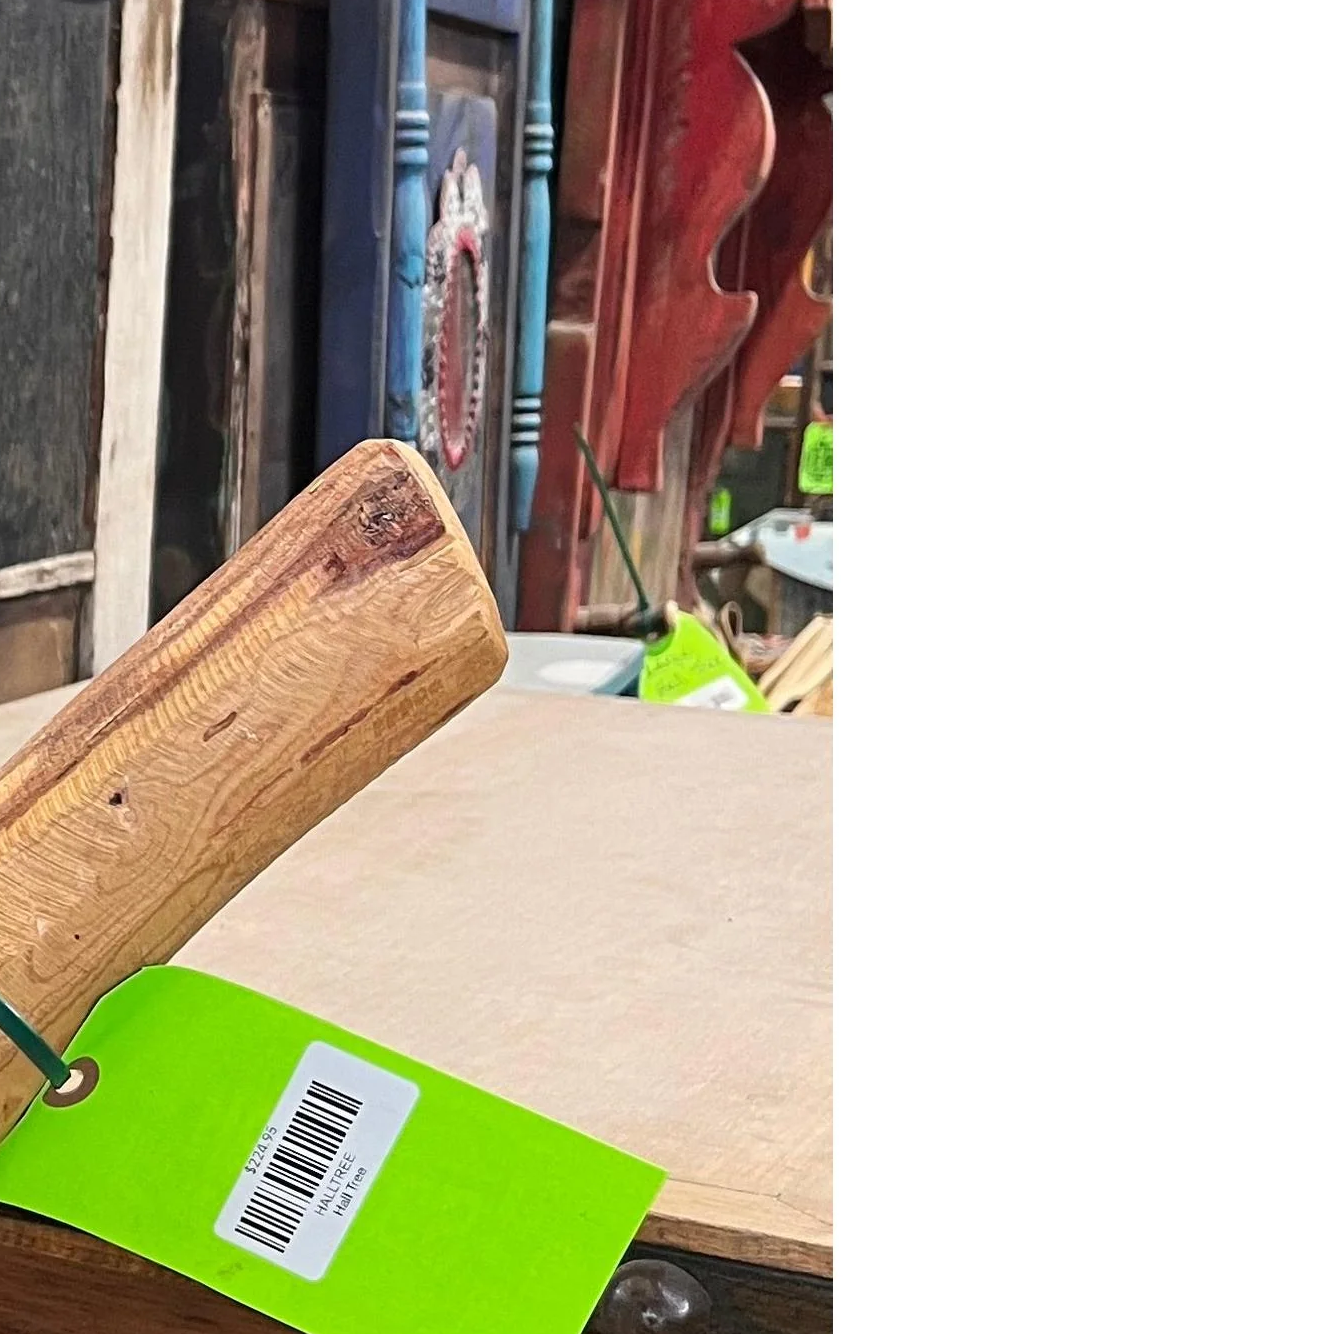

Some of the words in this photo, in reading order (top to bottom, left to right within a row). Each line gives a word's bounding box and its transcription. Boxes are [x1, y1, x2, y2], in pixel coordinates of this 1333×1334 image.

[244, 1125, 278, 1175] $224.95
[314, 1151, 356, 1216] HALLTREE
[333, 1191, 354, 1216] Hall
[345, 1166, 367, 1192] Tree
